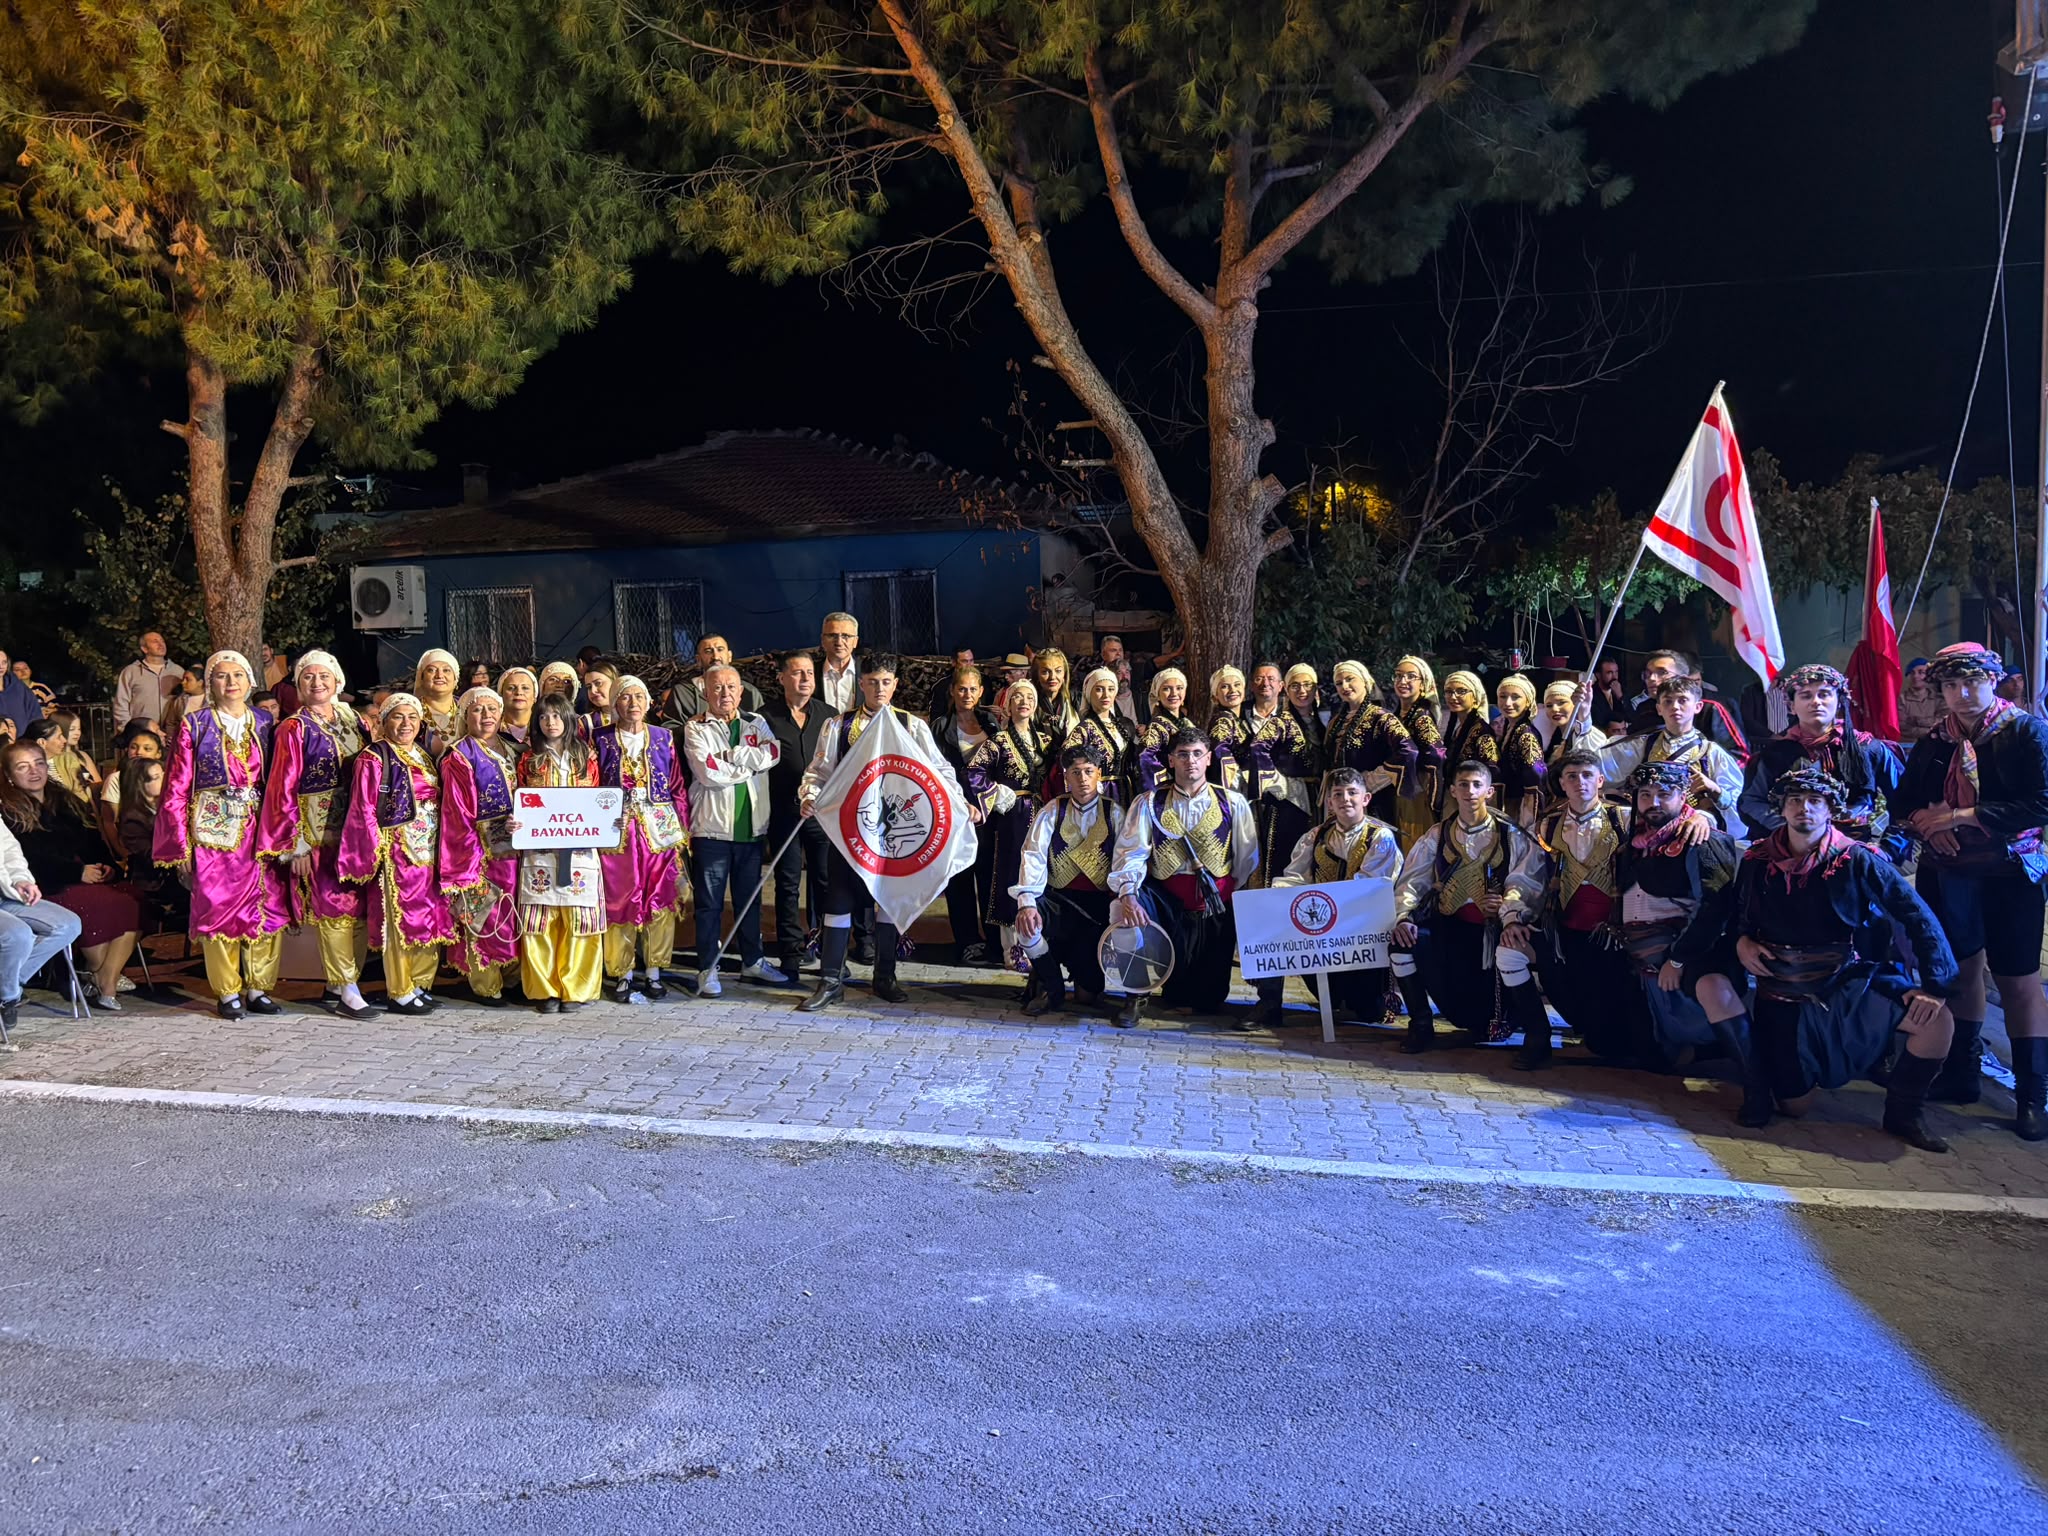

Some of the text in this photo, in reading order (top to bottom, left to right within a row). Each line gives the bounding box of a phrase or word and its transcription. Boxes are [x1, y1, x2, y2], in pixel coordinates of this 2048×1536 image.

[893, 759, 928, 781] KÜLTÜR
[927, 779, 938, 793] VE
[934, 793, 946, 825] SANAT
[548, 813, 584, 825] ATÇA
[531, 827, 600, 838] BAYANLAR
[1244, 931, 1392, 956] ALAYKÖY KÜLTÜR VE SANAT DERNEĞ
[1256, 948, 1376, 972] HALK DANSLARI
